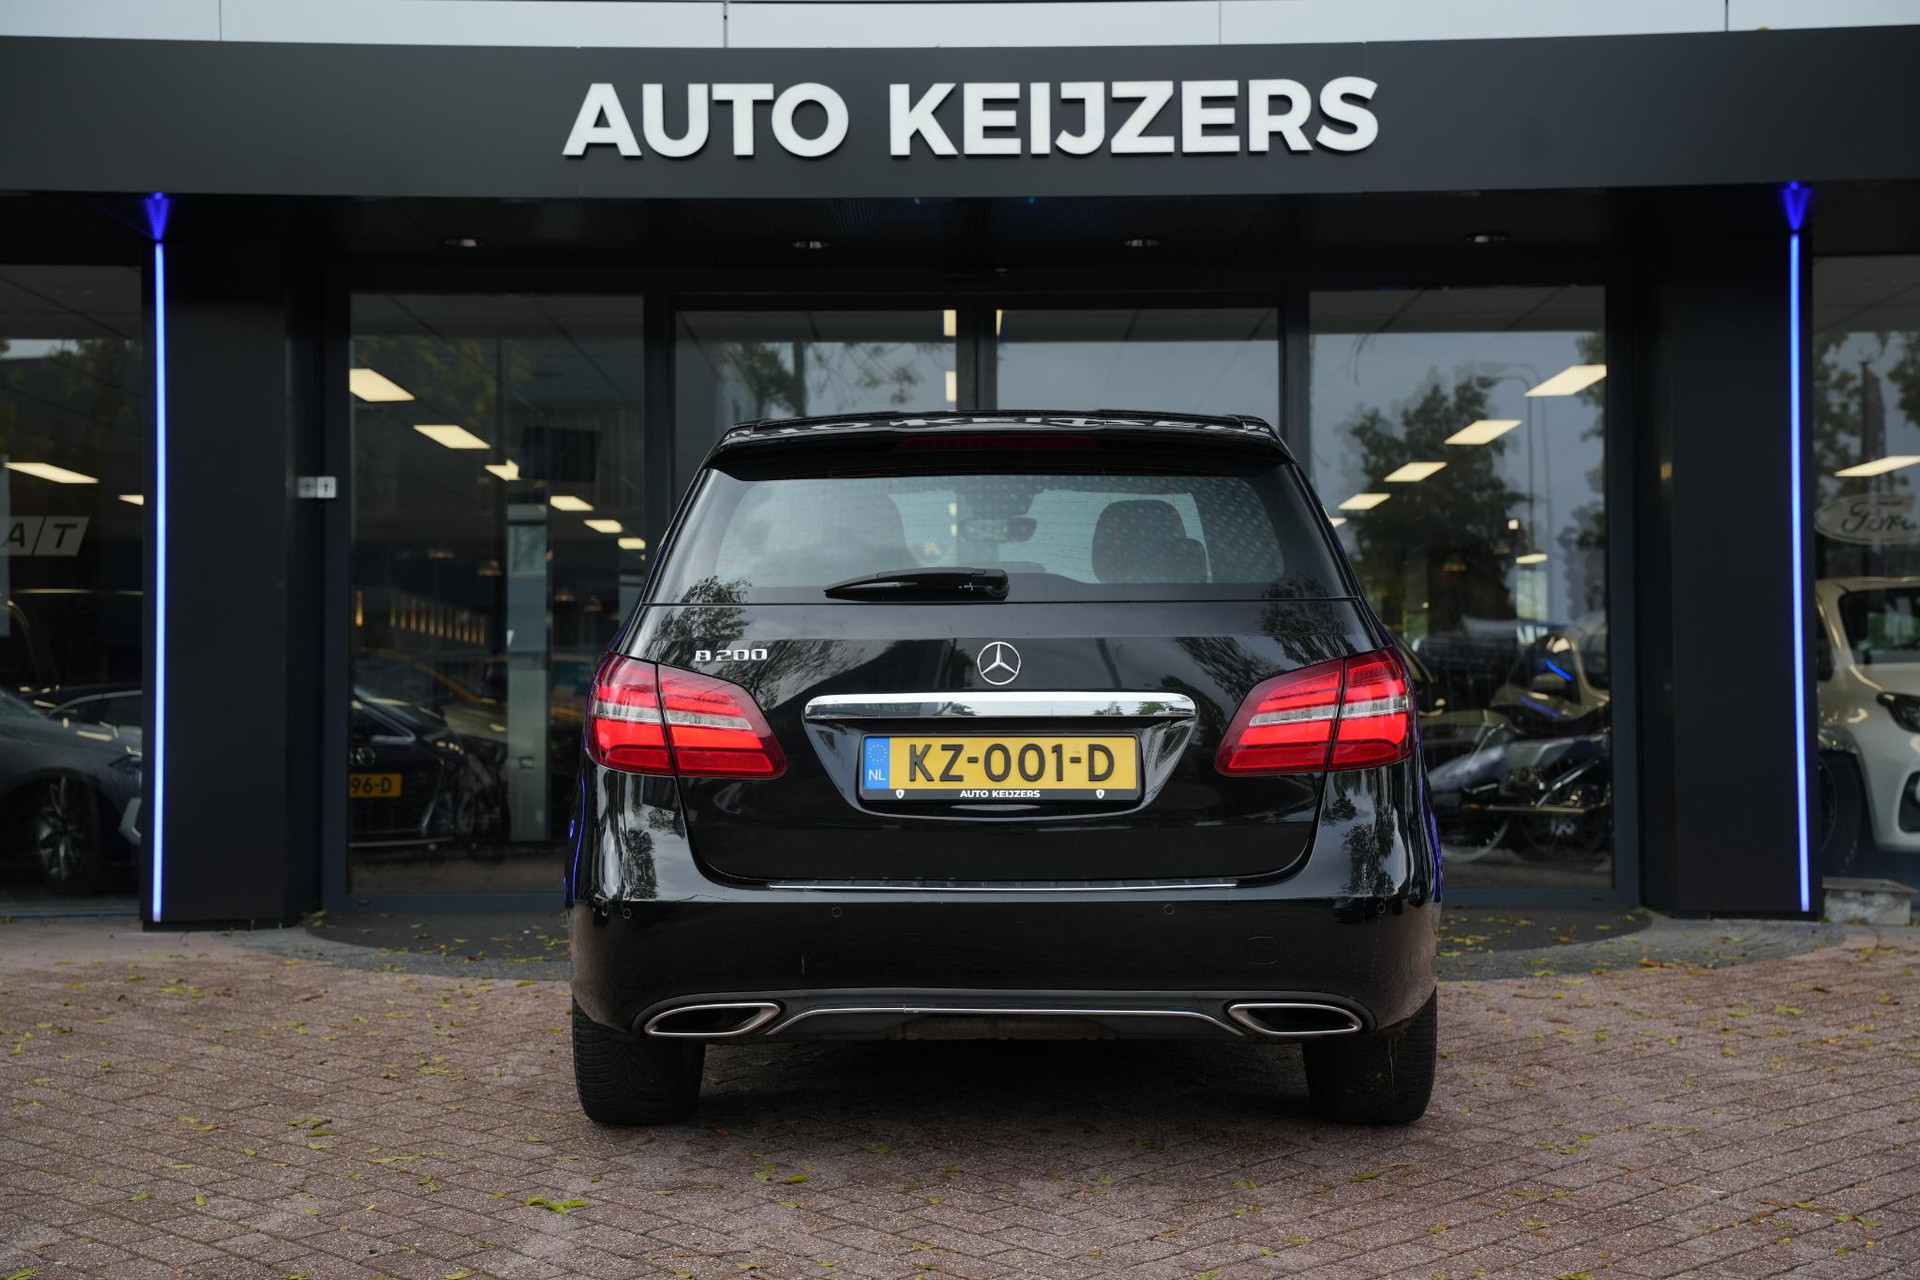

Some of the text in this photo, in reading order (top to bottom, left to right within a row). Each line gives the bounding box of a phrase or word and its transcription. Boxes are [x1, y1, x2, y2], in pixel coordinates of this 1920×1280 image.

[562, 76, 1380, 159] AUTO KEIJZERS
[695, 648, 768, 662] B 200
[908, 743, 1115, 782] KZ-001-D
[868, 769, 886, 781] NL
[959, 789, 1041, 799] AUTO KEIJZERS
